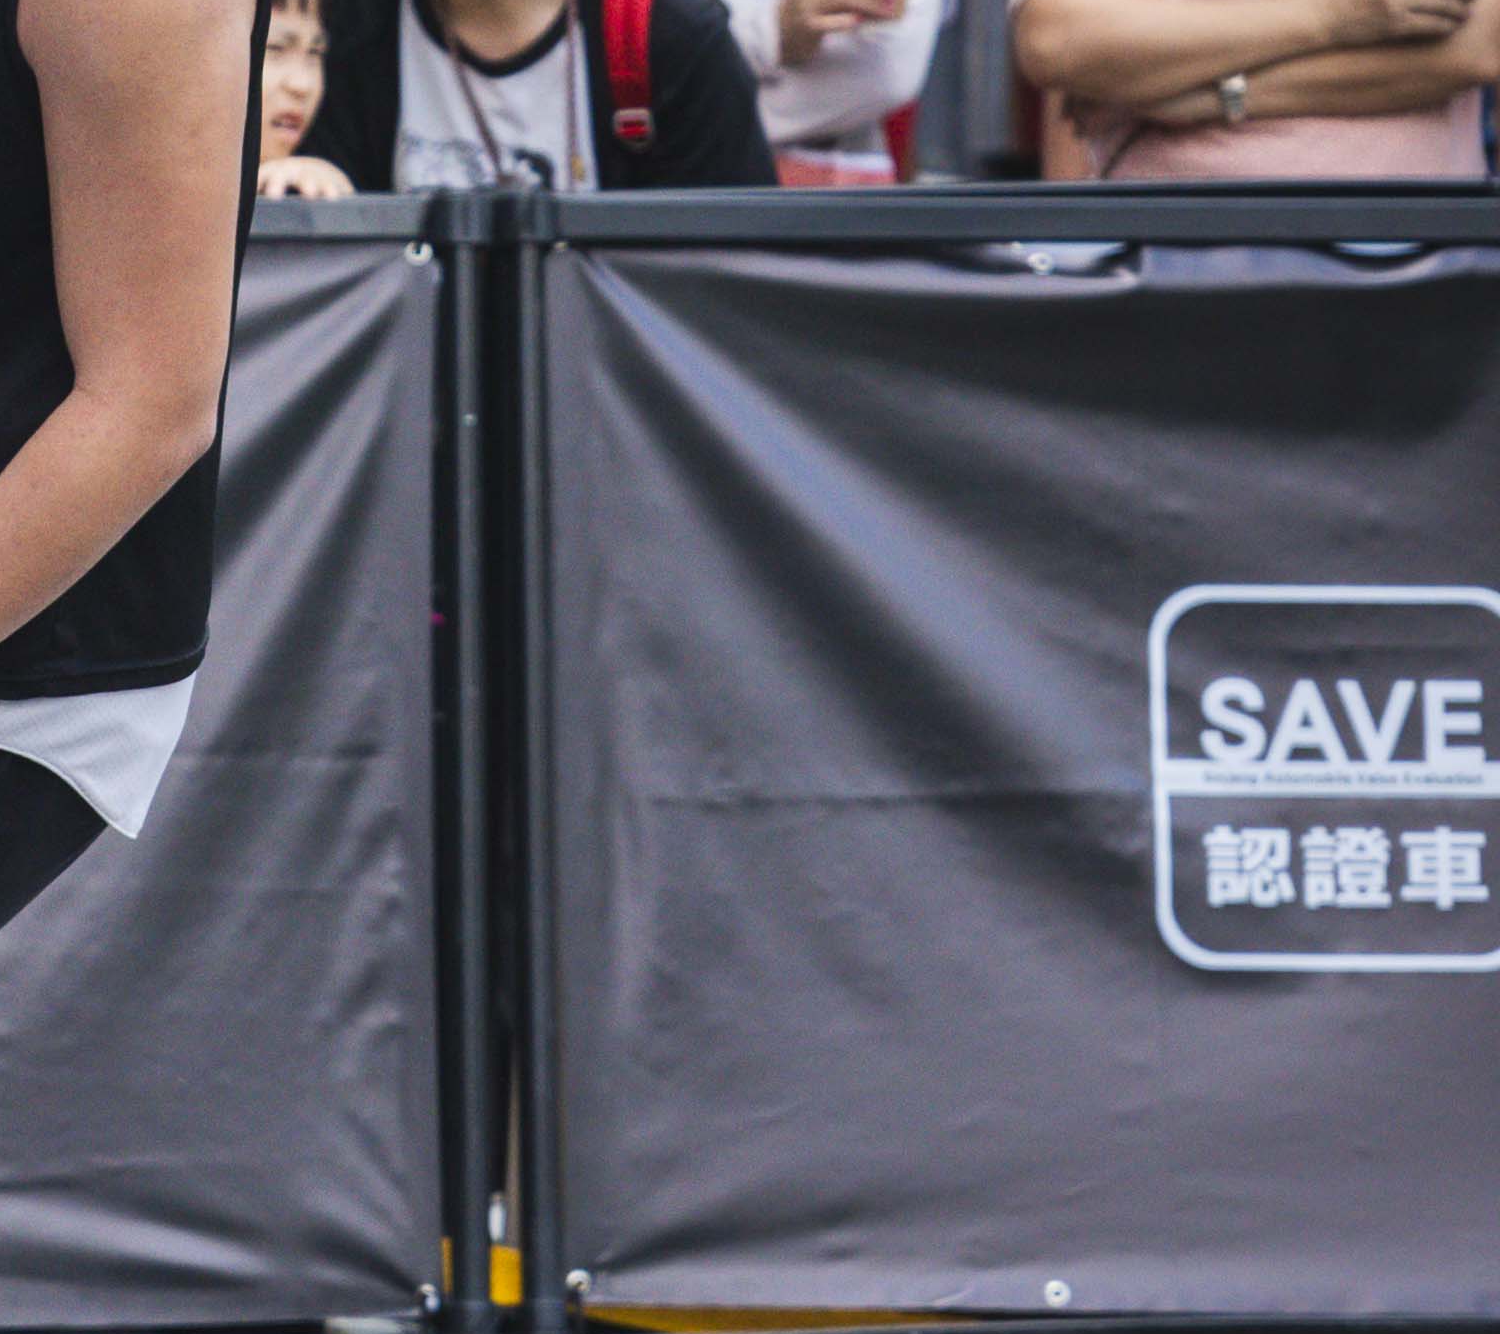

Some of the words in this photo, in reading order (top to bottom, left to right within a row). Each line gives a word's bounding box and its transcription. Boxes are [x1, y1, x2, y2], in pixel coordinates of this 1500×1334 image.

[1199, 675, 1487, 766] SAVE
[1202, 824, 1490, 911] 認證車
